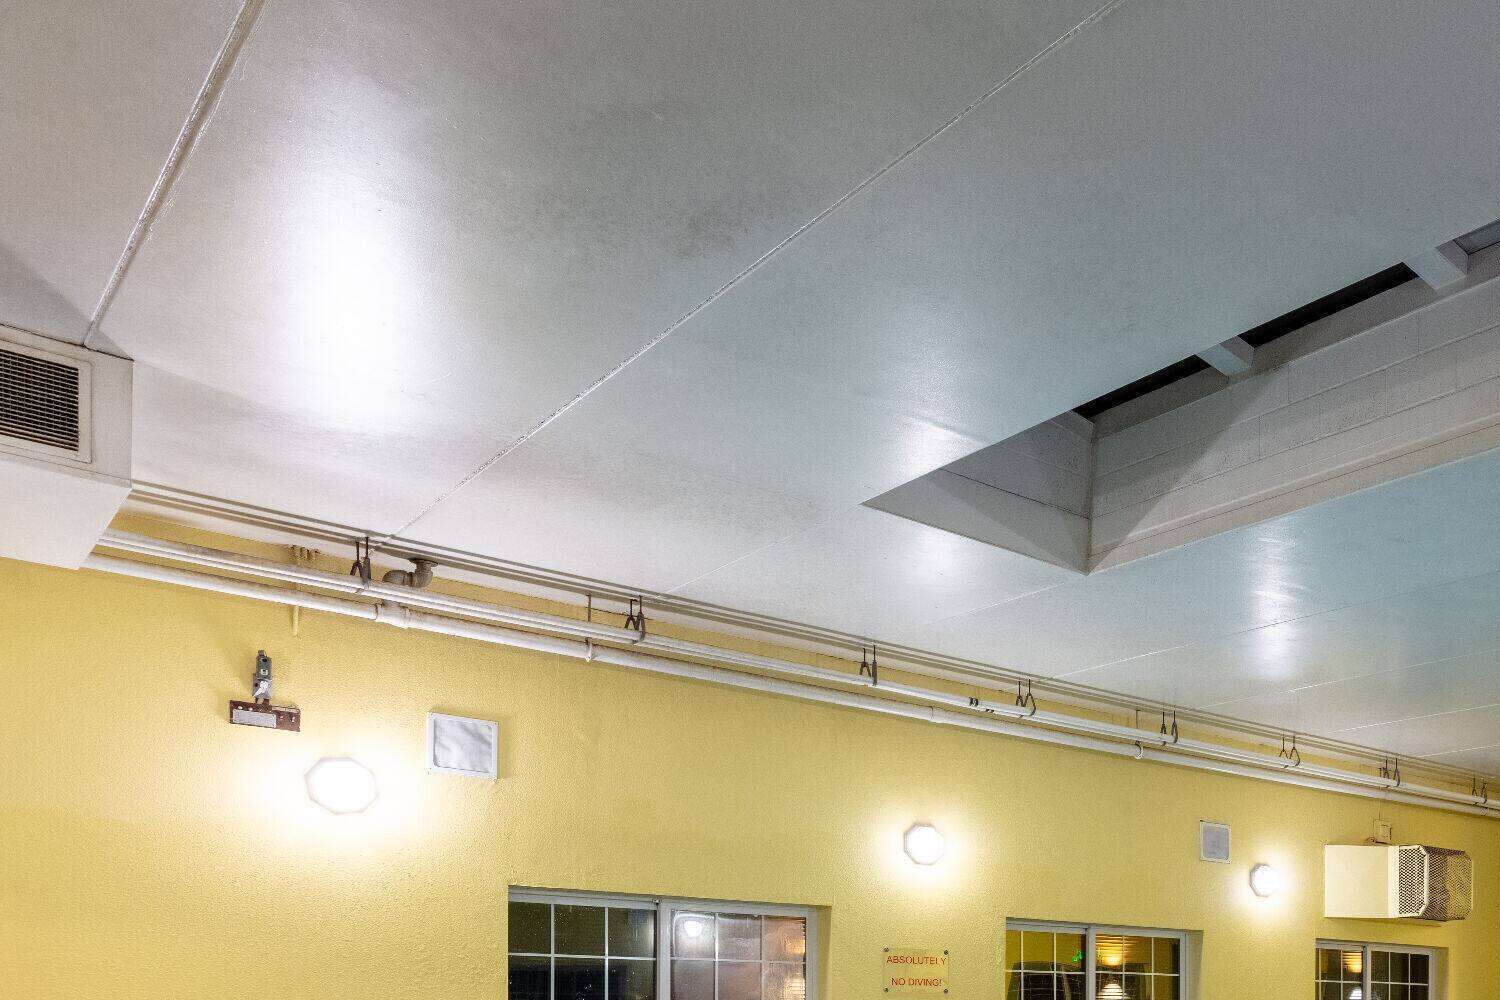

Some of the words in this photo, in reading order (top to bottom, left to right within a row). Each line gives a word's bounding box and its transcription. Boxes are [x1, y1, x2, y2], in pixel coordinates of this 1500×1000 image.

[886, 955, 946, 965] ABSOLUTELY
[891, 977, 906, 986] NO
[908, 978, 942, 987] DIVING!
